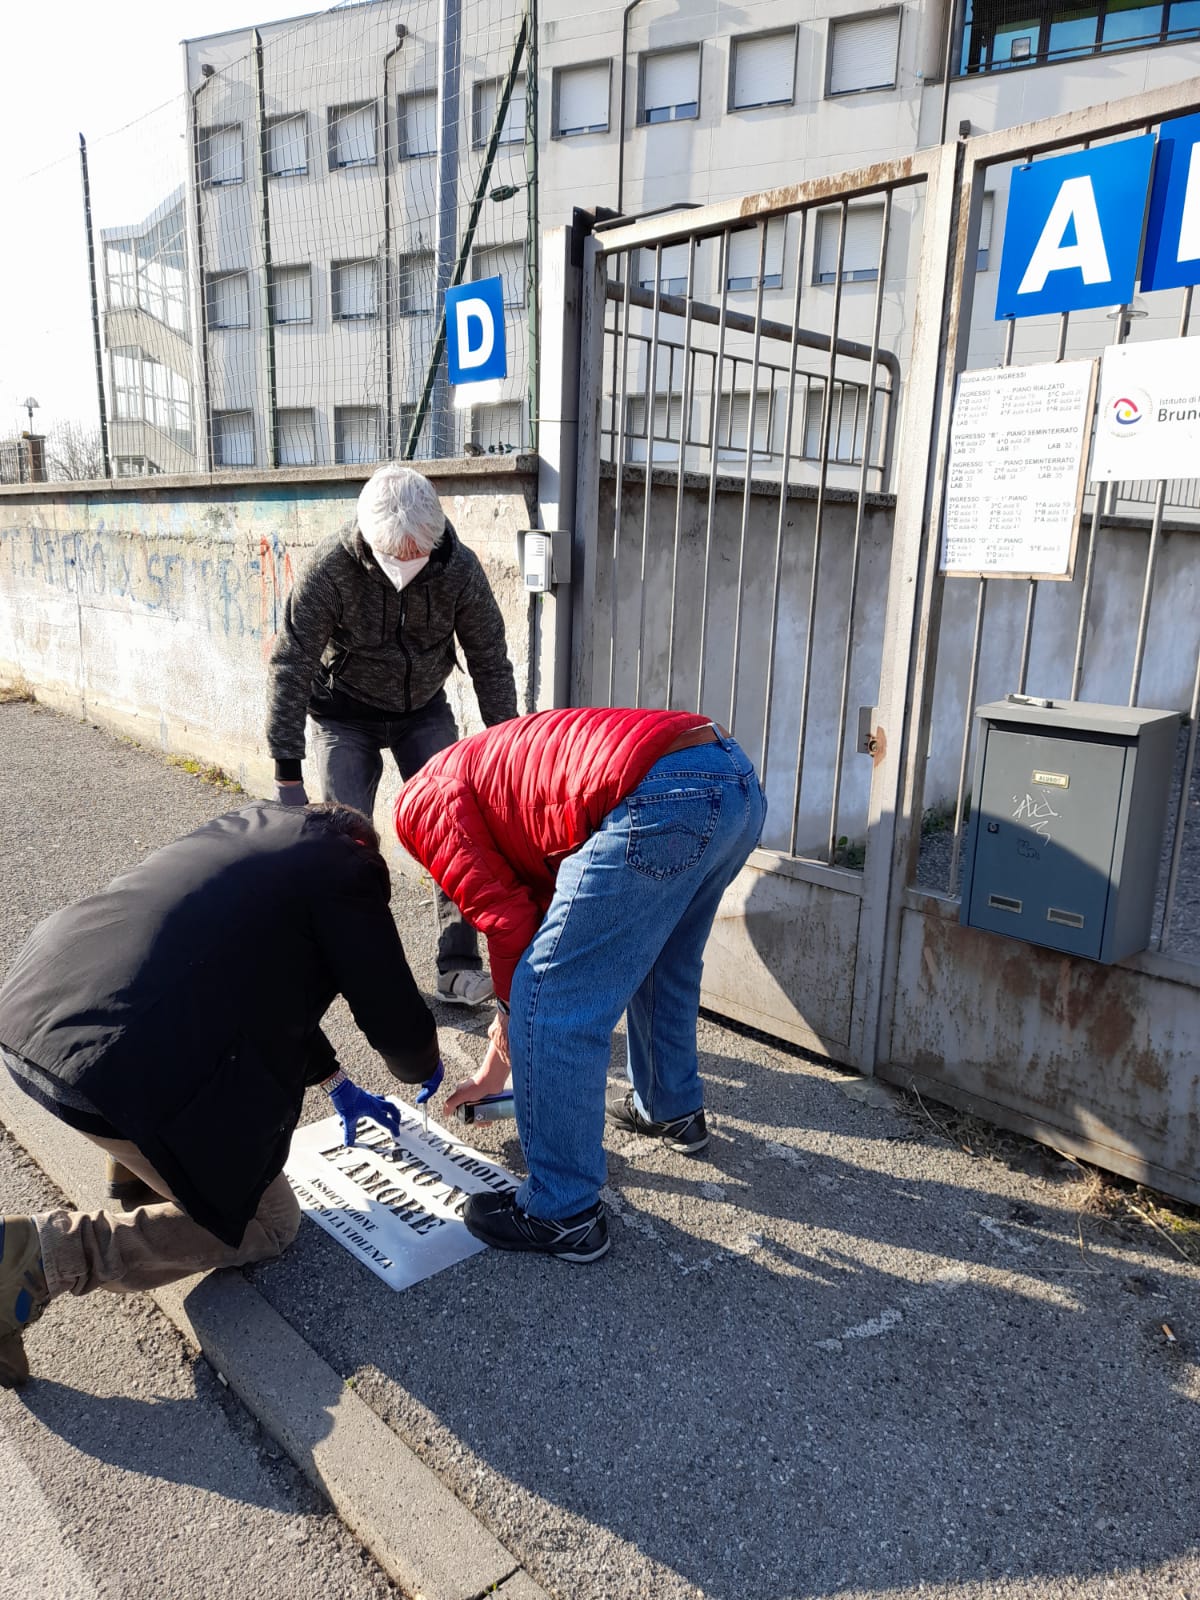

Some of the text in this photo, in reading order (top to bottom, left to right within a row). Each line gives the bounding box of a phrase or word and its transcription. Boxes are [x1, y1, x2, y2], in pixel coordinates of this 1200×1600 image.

[1017, 175, 1112, 295] A
[456, 298, 494, 369] D
[996, 372, 1026, 380] INGRESSI
[1033, 383, 1065, 391] RIALZATO
[1026, 427, 1078, 436] SEMINTERRATO
[1158, 408, 1200, 422] Brun
[307, 1177, 380, 1234] ASSOCIAZIONE
[337, 1161, 447, 1236] AMORE
[327, 1215, 346, 1229] LA
[341, 1227, 394, 1270] VIOLENZA
